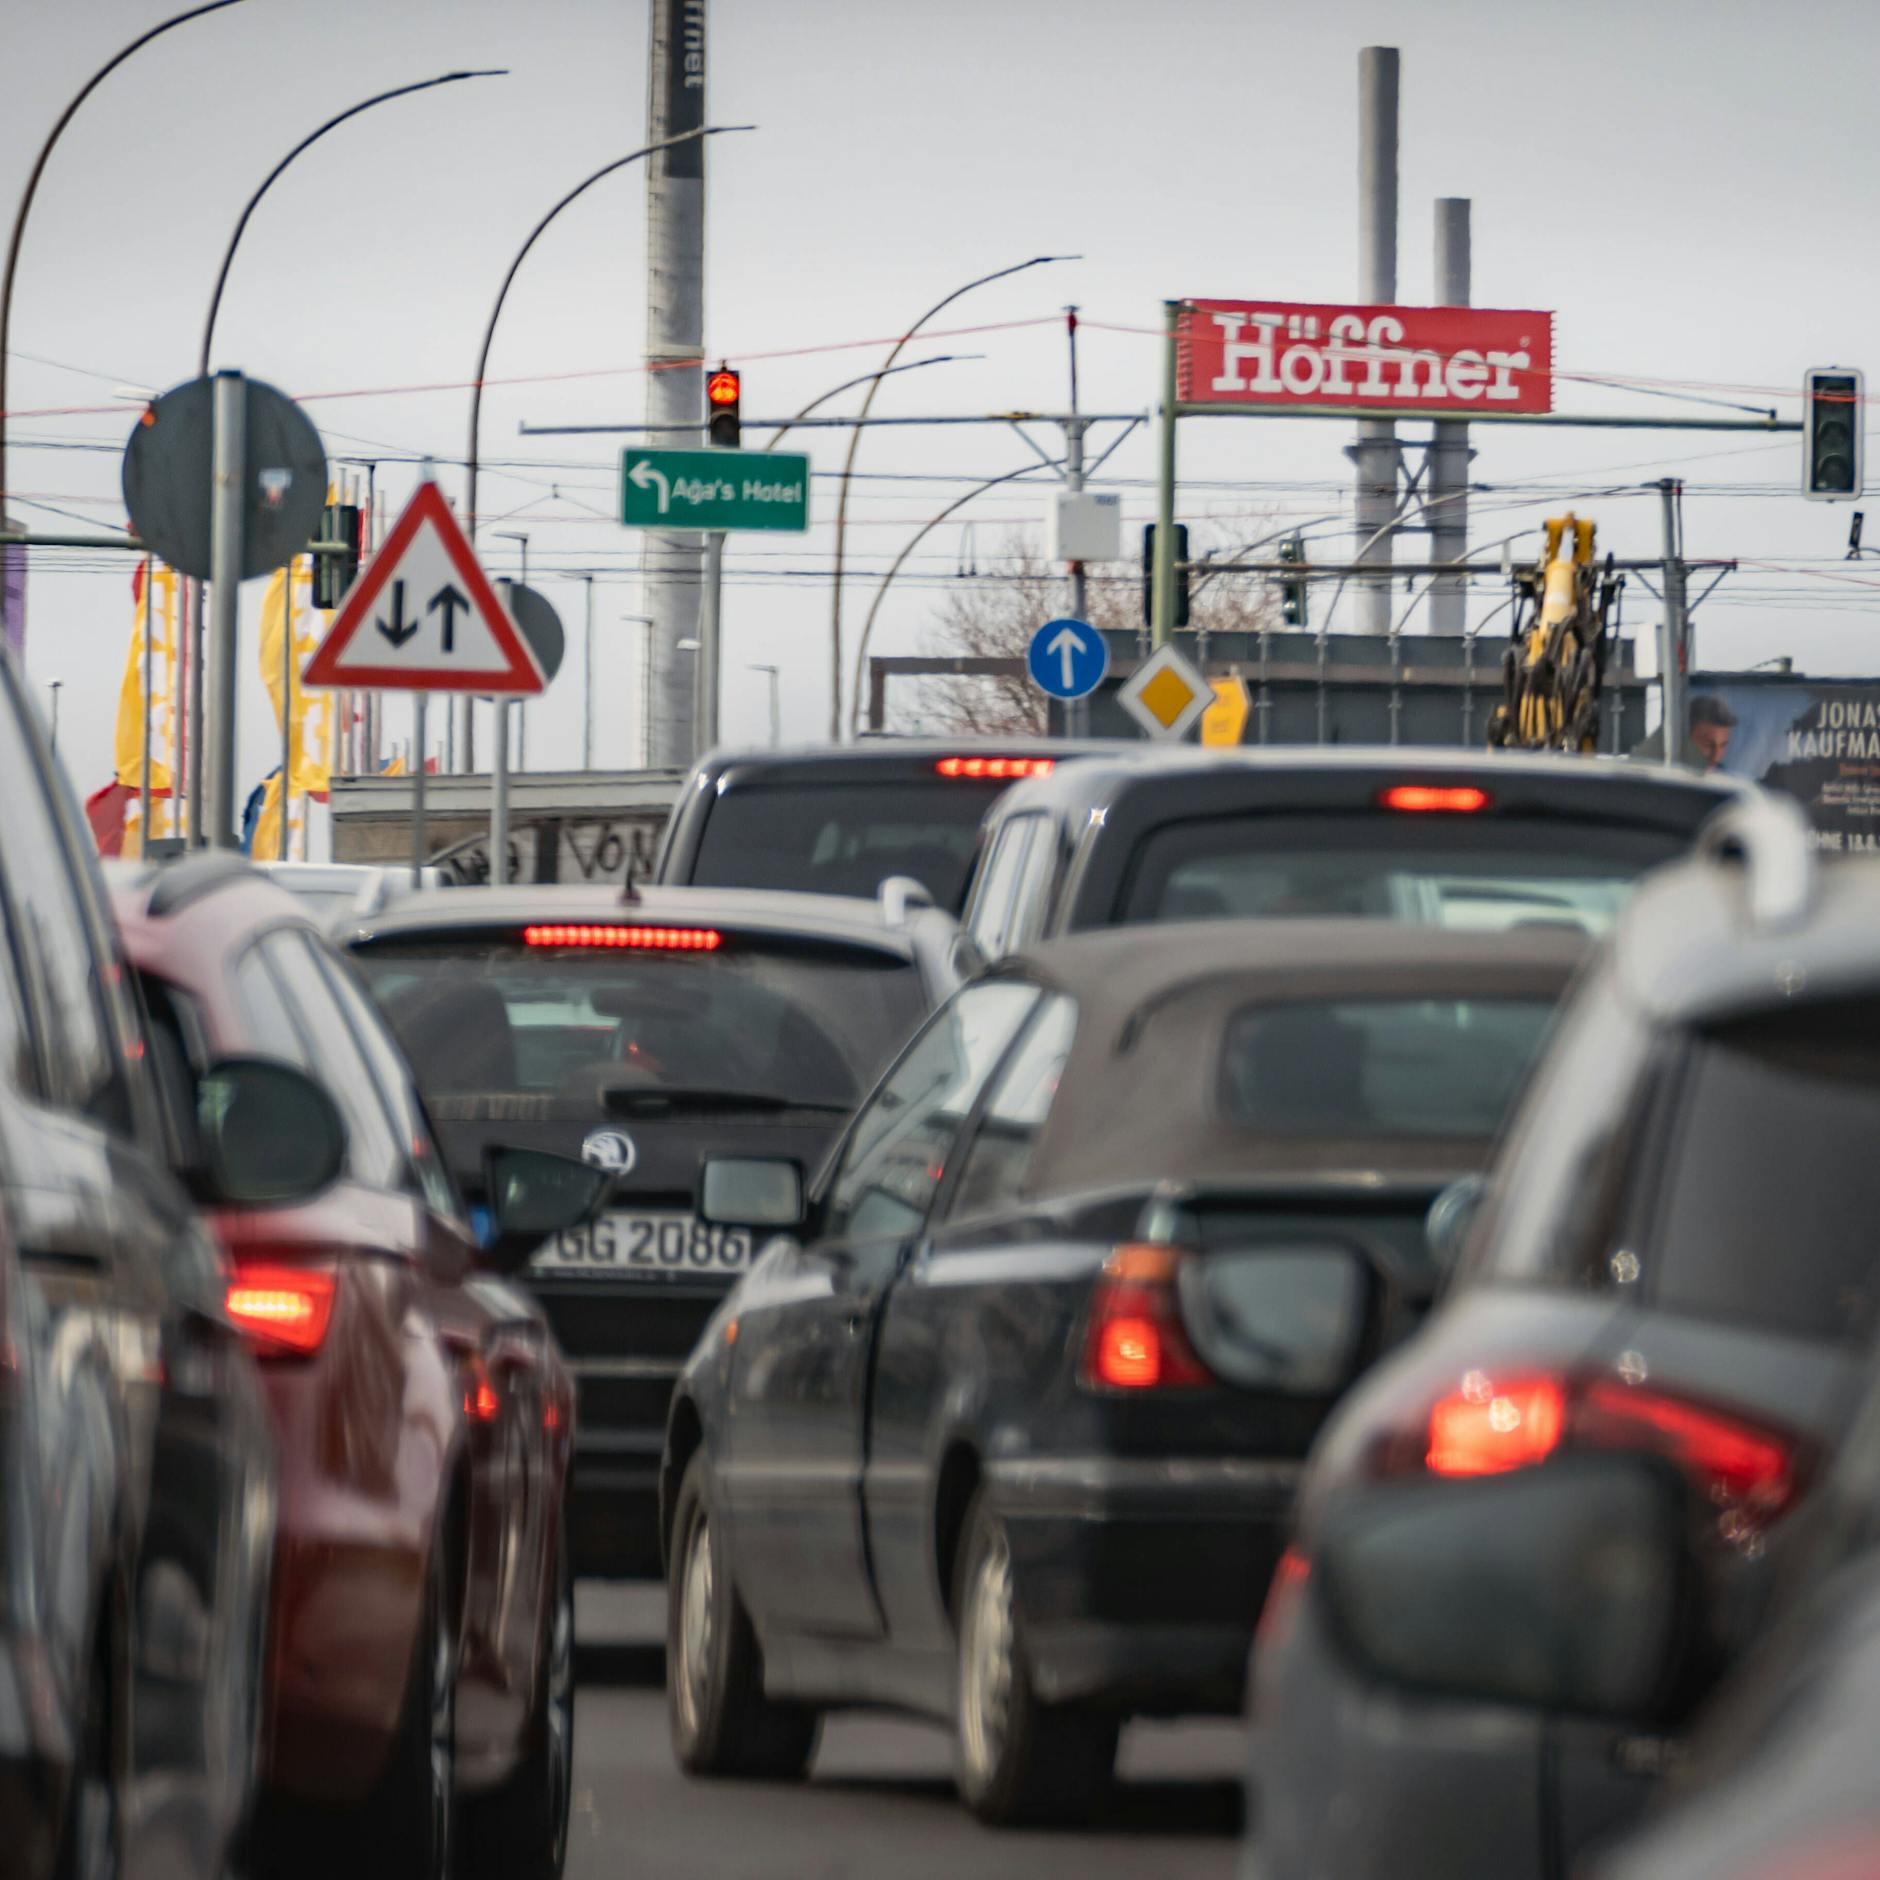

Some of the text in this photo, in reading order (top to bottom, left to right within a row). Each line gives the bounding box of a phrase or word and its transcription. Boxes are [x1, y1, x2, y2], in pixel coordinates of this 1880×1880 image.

[1212, 312, 1531, 400] Höffner
[742, 479, 802, 503] Hotel
[627, 1220, 745, 1268] 2086
